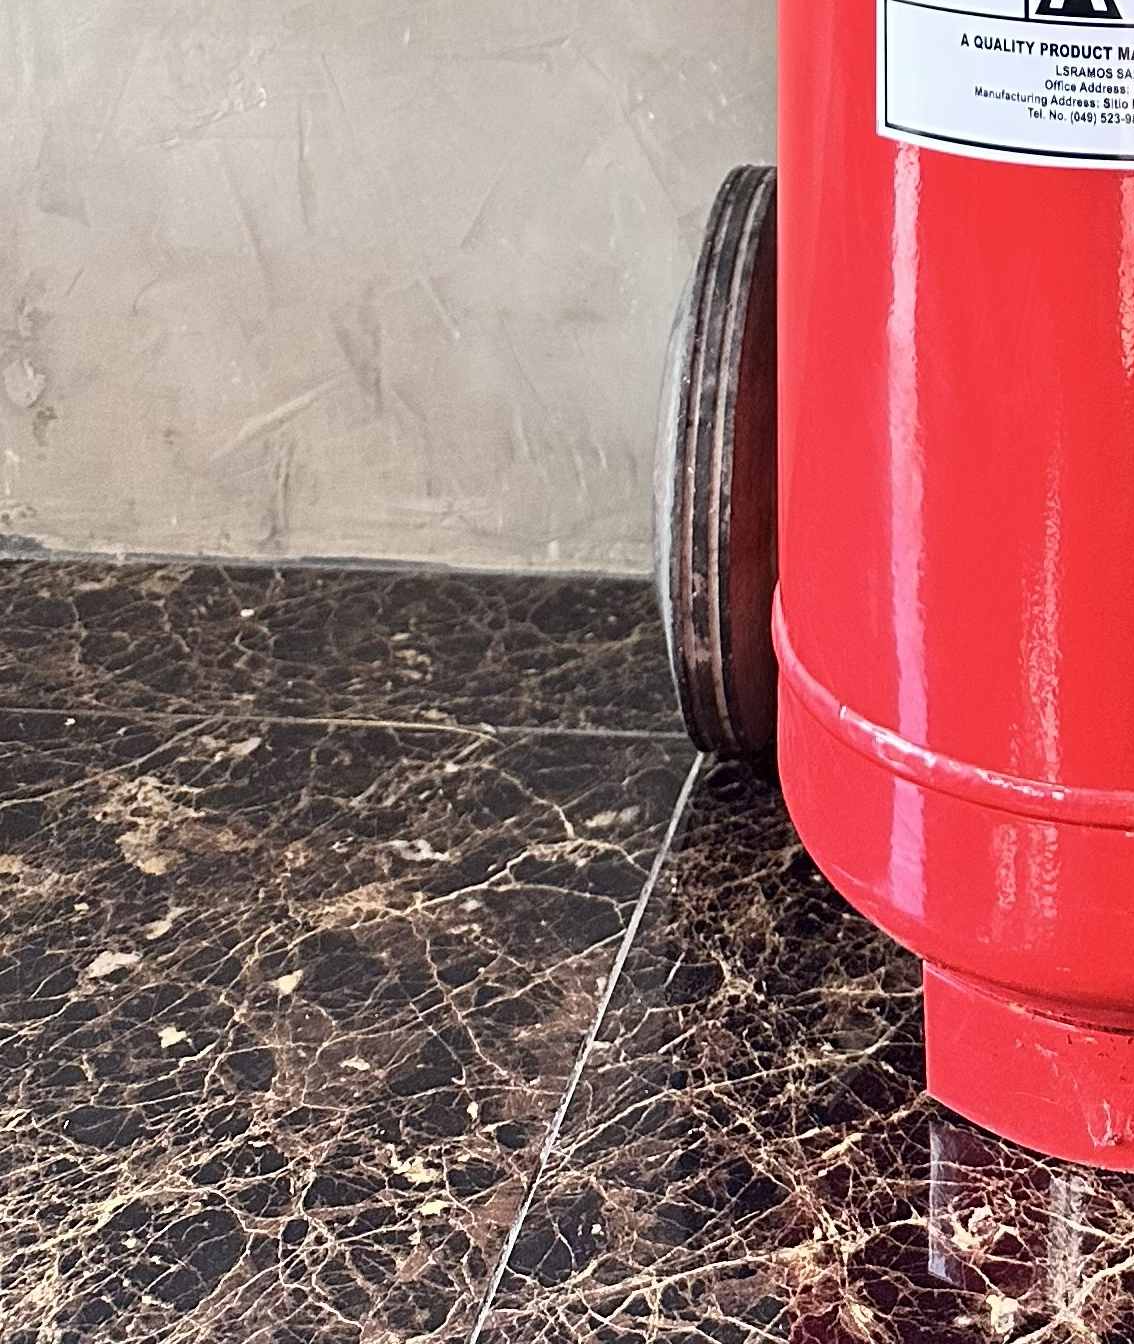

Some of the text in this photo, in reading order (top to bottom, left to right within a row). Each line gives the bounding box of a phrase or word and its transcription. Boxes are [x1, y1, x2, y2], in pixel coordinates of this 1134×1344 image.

[961, 33, 969, 47] A
[974, 35, 1035, 55] QUALITY
[1040, 42, 1112, 60] PRODUCT
[1056, 65, 1113, 79] LSRAMOS
[1045, 80, 1076, 92] Office
[1080, 82, 1129, 94] Address:
[975, 86, 1048, 106] Manufacturing
[1050, 95, 1099, 109] Address:
[1028, 107, 1097, 126] Tel. No. (049)
